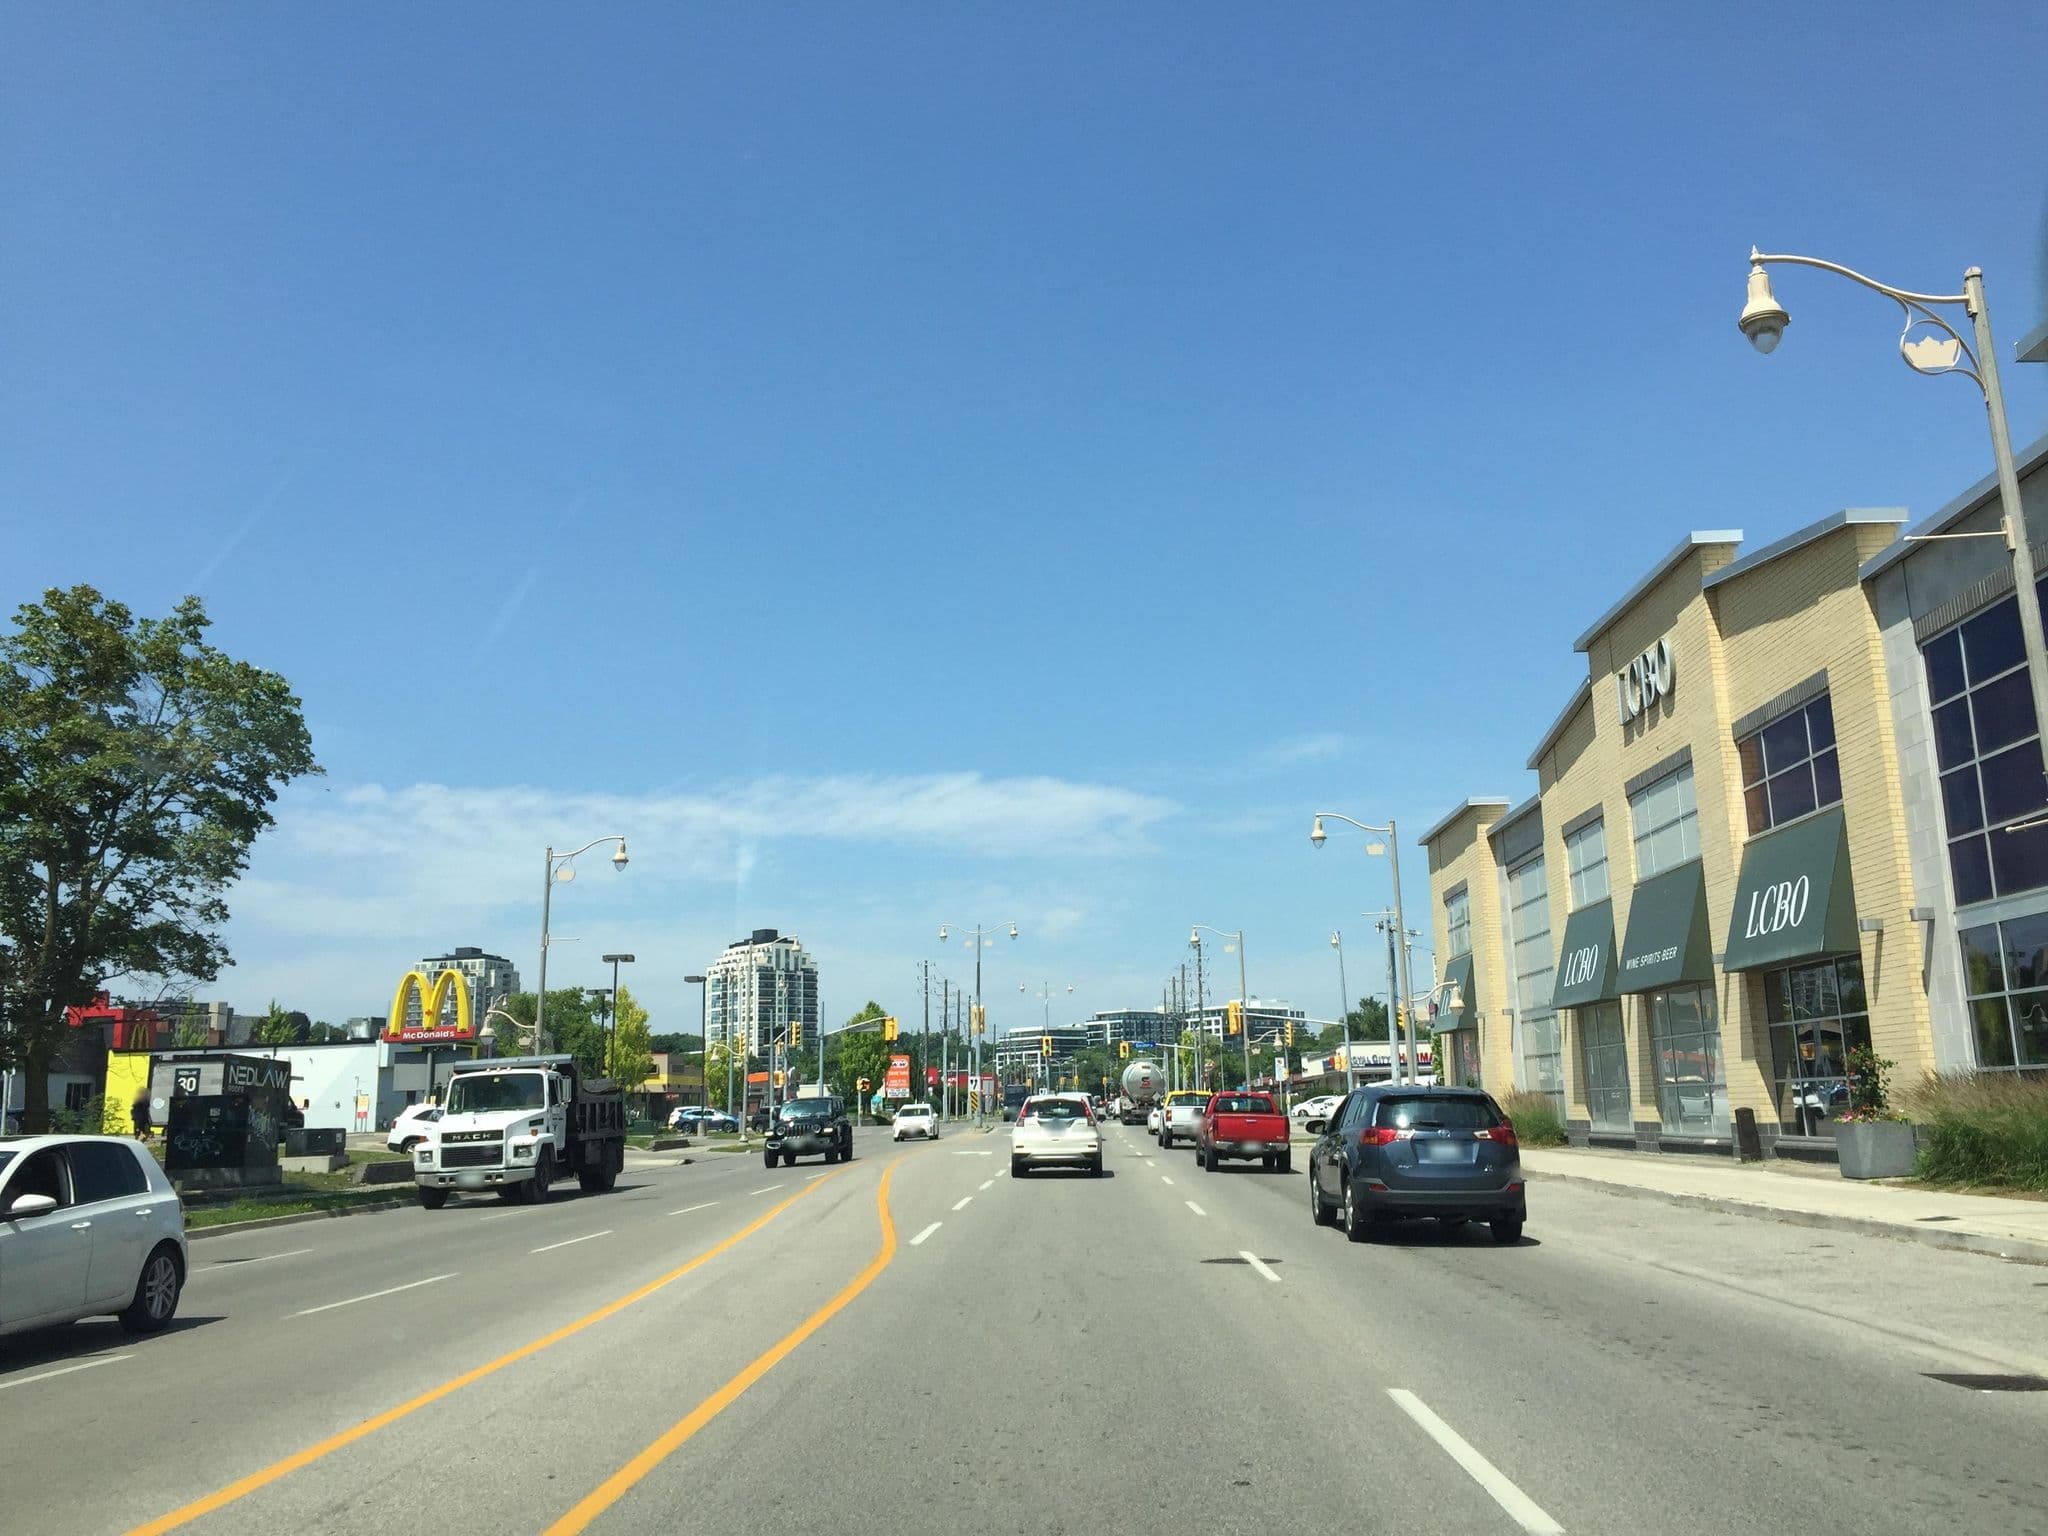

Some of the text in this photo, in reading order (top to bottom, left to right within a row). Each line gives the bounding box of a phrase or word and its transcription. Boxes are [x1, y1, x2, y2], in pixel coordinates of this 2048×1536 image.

[1616, 637, 1672, 725] LCBO
[1744, 875, 1809, 939] LCBO
[1564, 944, 1598, 987] LCBO
[1626, 957, 1640, 970] WINE
[1661, 946, 1678, 961] BEER
[403, 1030, 455, 1039] McDonald's
[228, 1064, 289, 1088] NEDLAW
[452, 1133, 491, 1141] MACK
